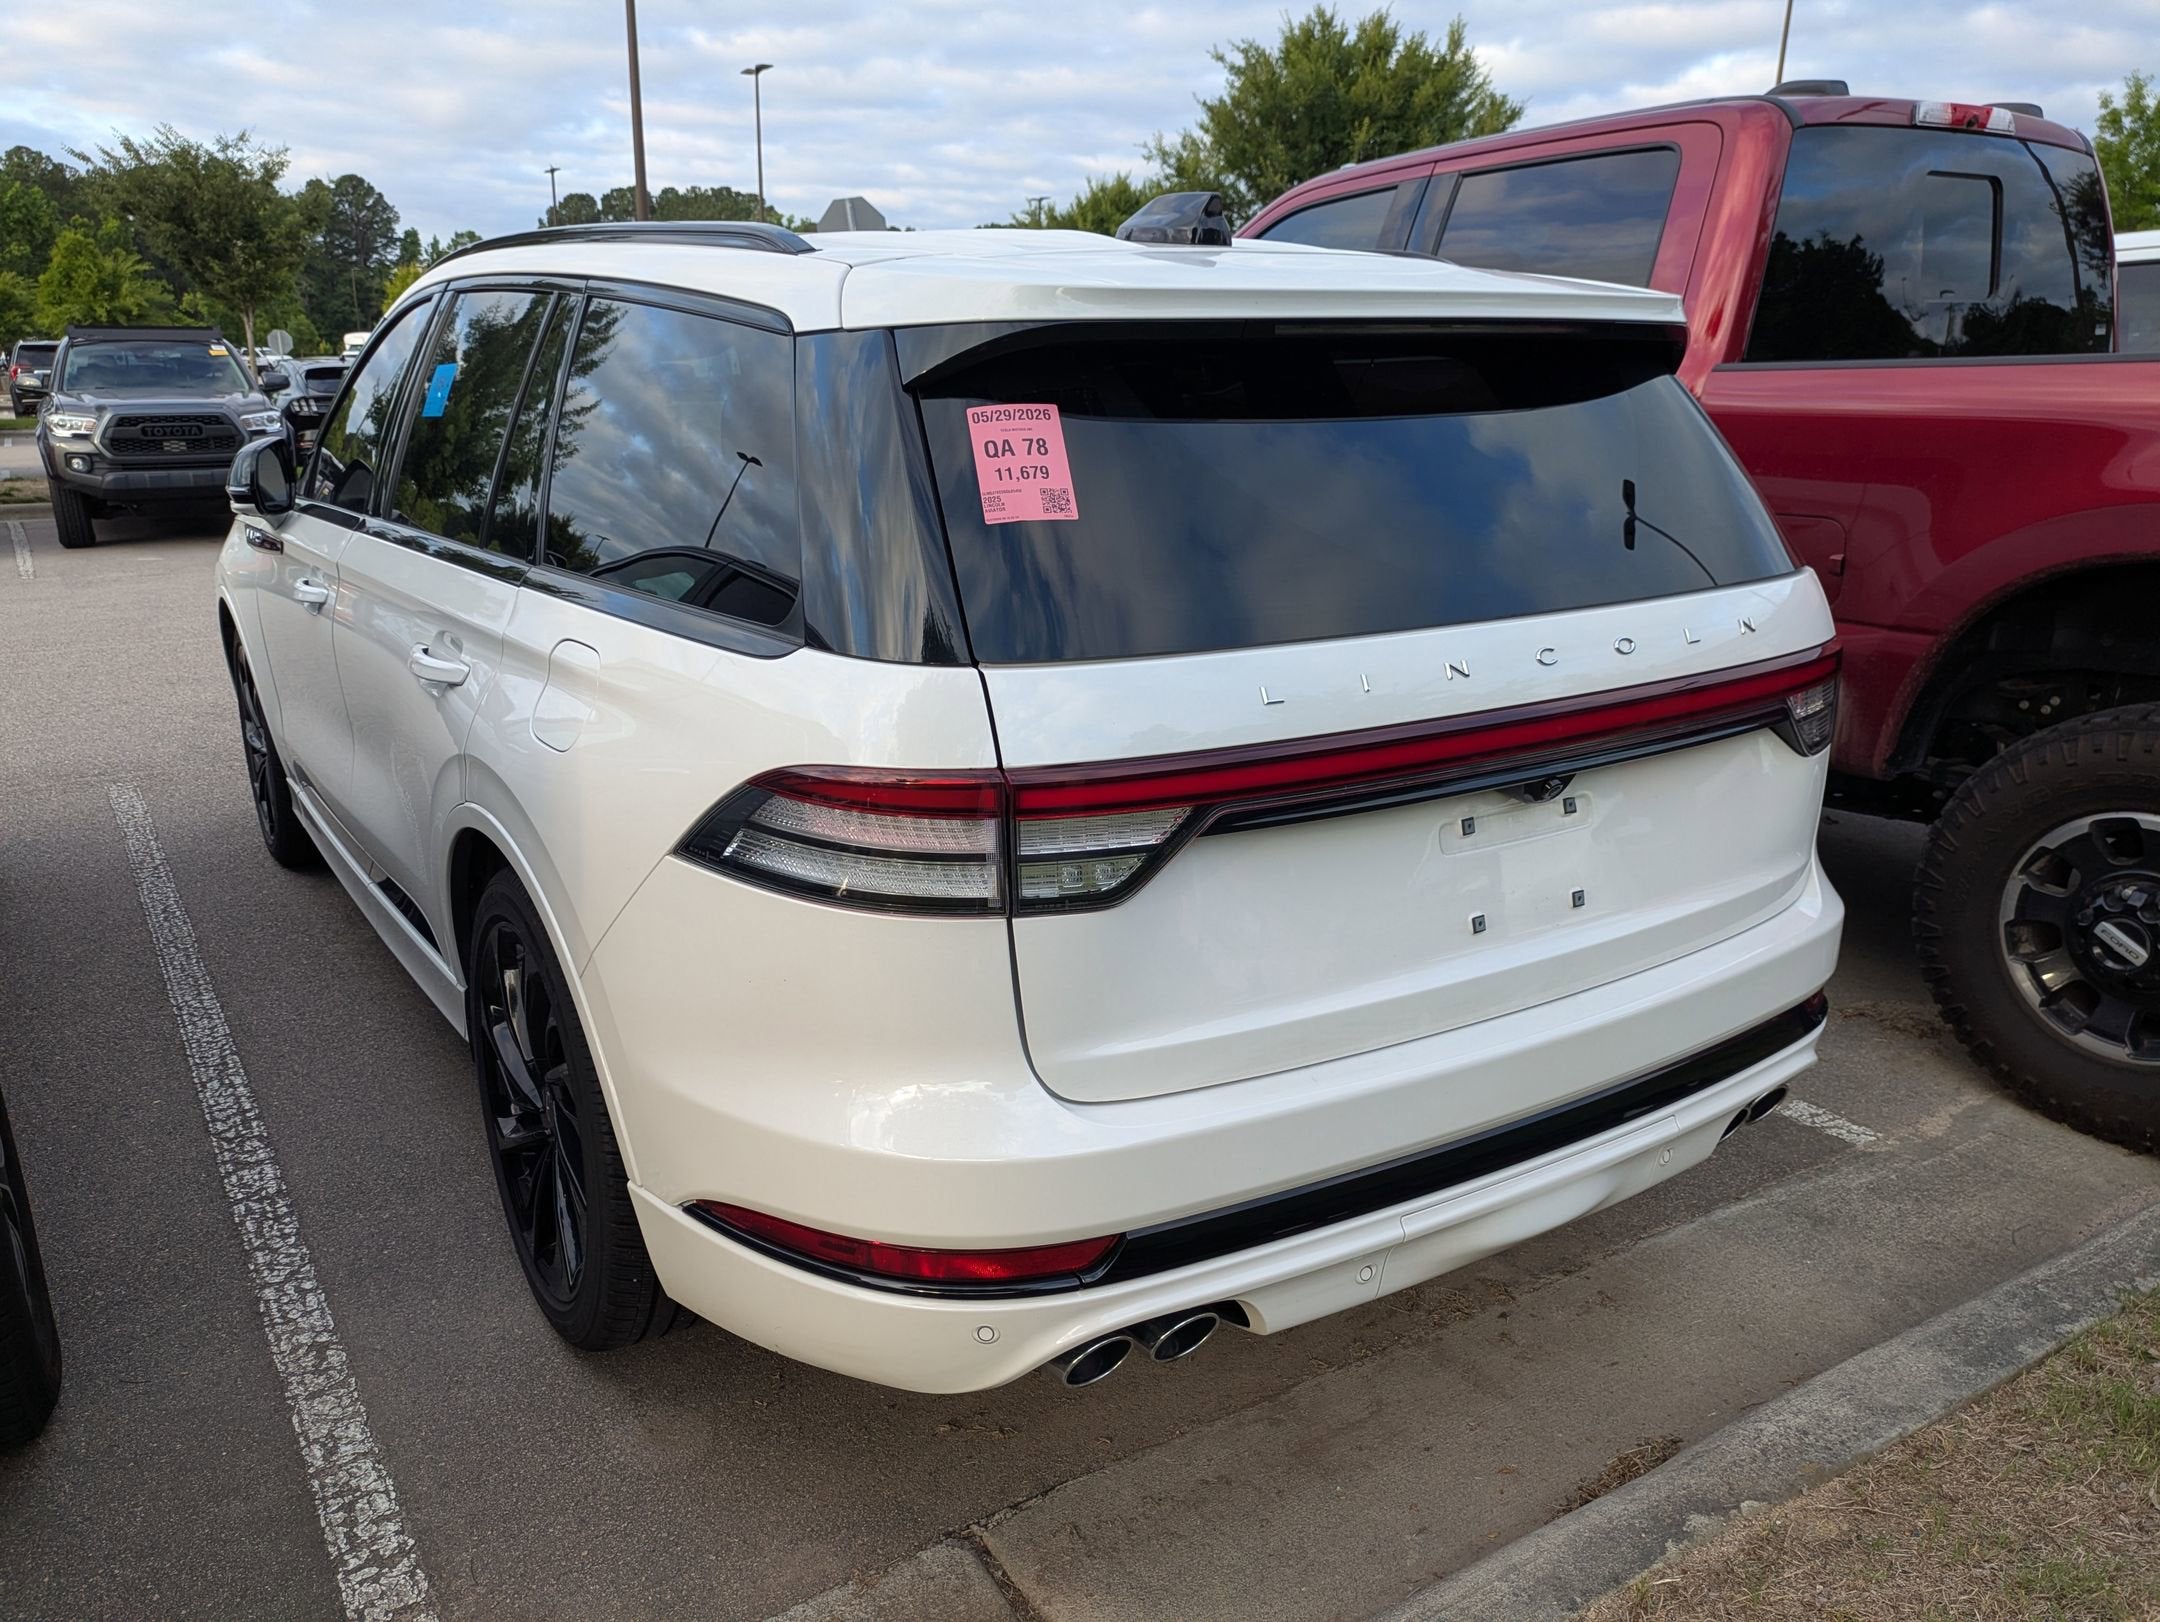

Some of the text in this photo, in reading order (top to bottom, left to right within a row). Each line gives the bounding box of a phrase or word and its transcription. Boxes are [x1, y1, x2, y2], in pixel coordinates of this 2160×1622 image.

[971, 408, 1052, 424] 05/29/2026
[144, 426, 201, 438] TOYOTA
[983, 438, 1049, 459] QA 78
[994, 465, 1050, 483] 11,679
[983, 495, 1002, 504] 2025
[1258, 616, 1757, 706] LINCOLN
[2100, 929, 2140, 960] FORD
